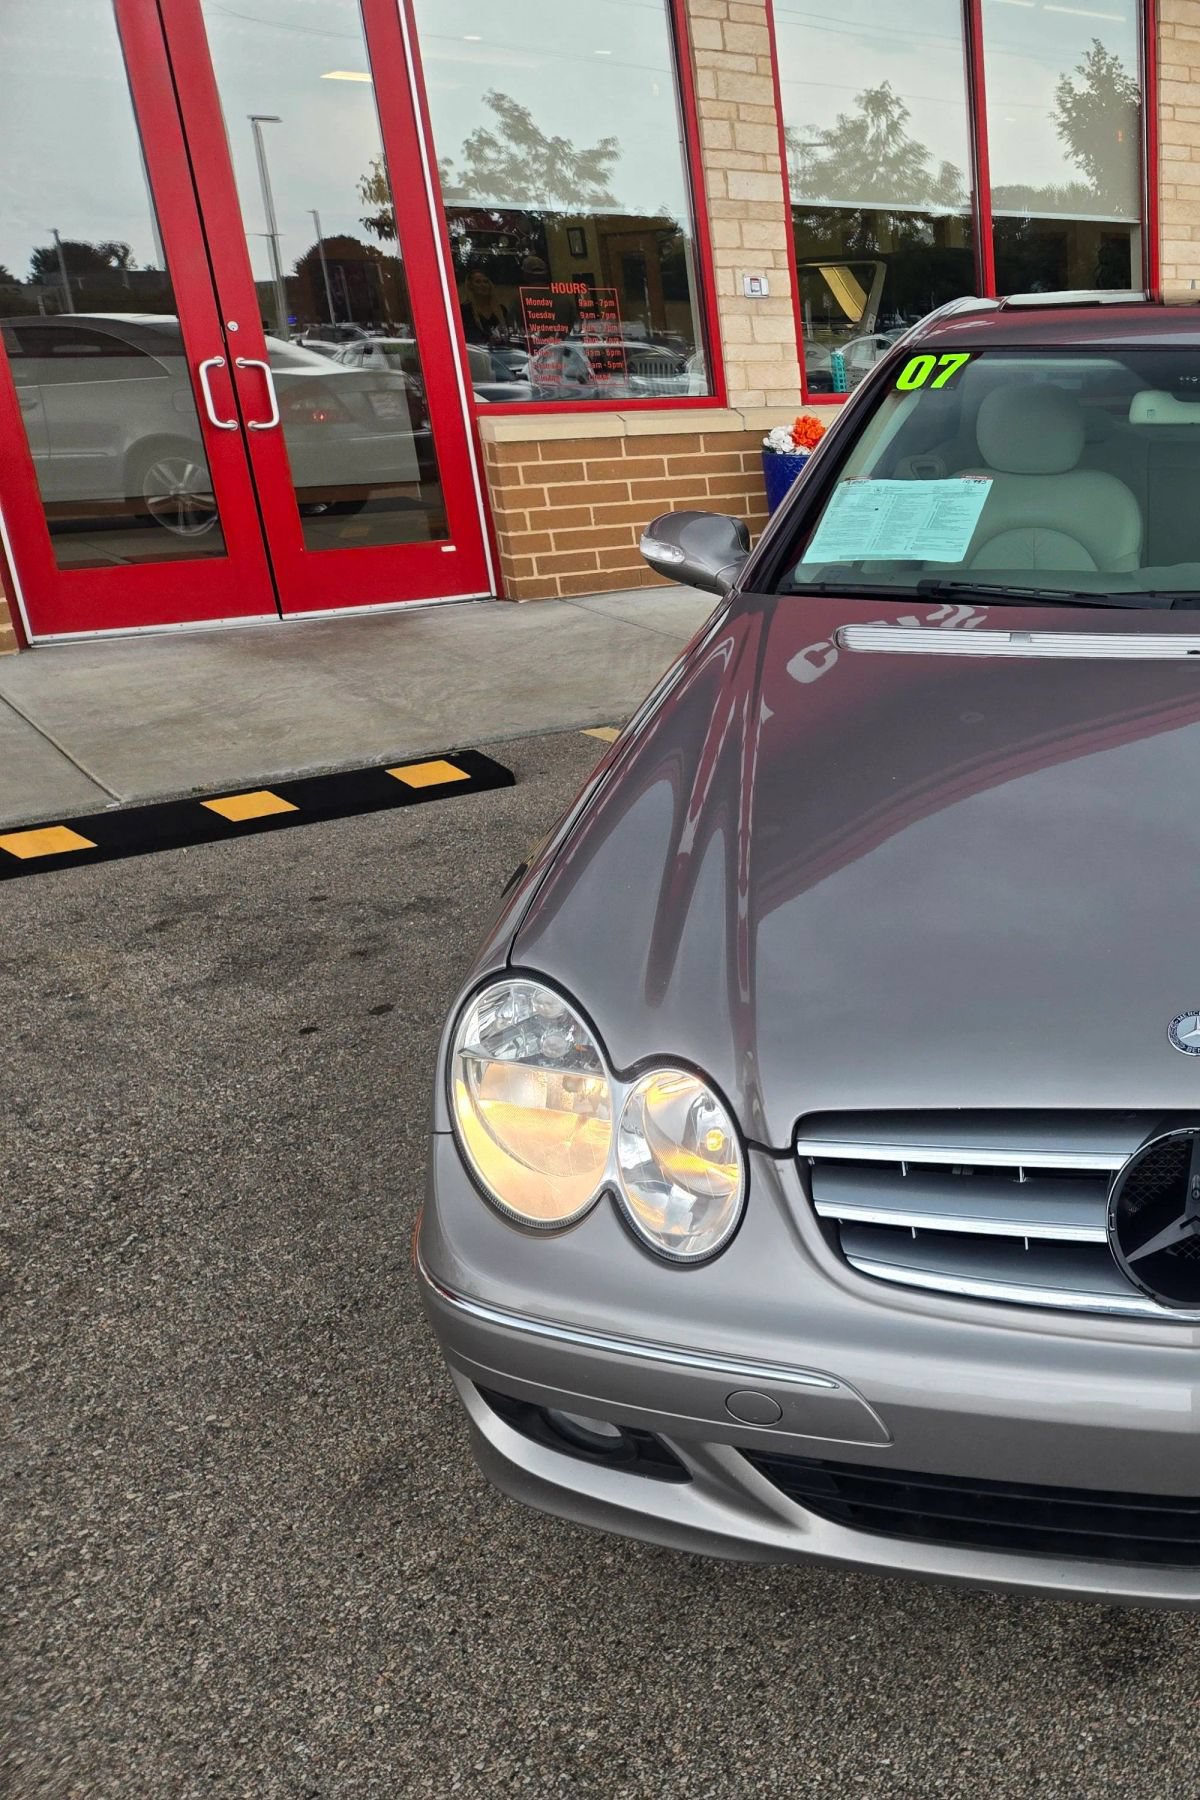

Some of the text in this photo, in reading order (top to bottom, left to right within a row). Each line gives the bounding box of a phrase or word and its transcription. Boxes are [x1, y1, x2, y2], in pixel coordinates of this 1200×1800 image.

[551, 282, 587, 294] HOURS
[526, 298, 553, 308] Monday
[578, 298, 593, 307] 9am
[600, 298, 615, 308] 7pm
[527, 311, 556, 320] Tuesday
[579, 311, 595, 319] 9am
[601, 311, 616, 320] 7pm
[529, 323, 569, 333] Wednesday
[607, 361, 624, 370] 5pm
[896, 353, 971, 390] 07
